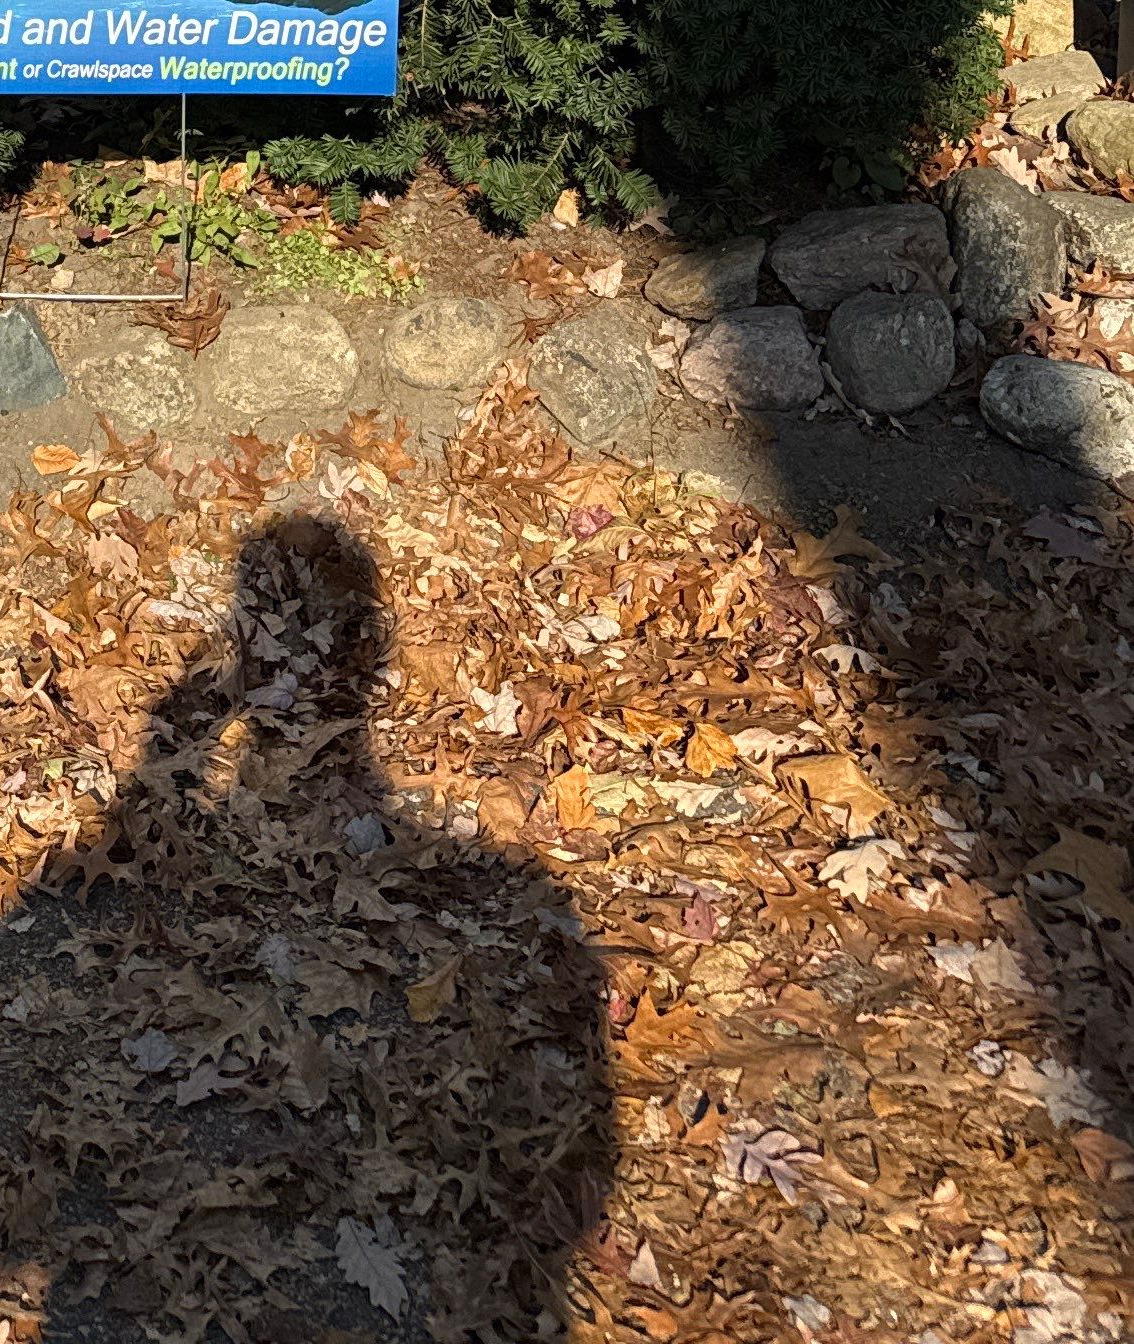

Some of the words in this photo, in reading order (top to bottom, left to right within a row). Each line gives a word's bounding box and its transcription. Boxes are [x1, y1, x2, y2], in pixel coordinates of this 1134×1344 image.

[21, 10, 94, 45] and
[106, 10, 219, 45] Water
[227, 11, 387, 55] Damage
[23, 63, 42, 78] or
[46, 59, 153, 82] Crawlspace
[159, 56, 351, 86] Waterproofing?
